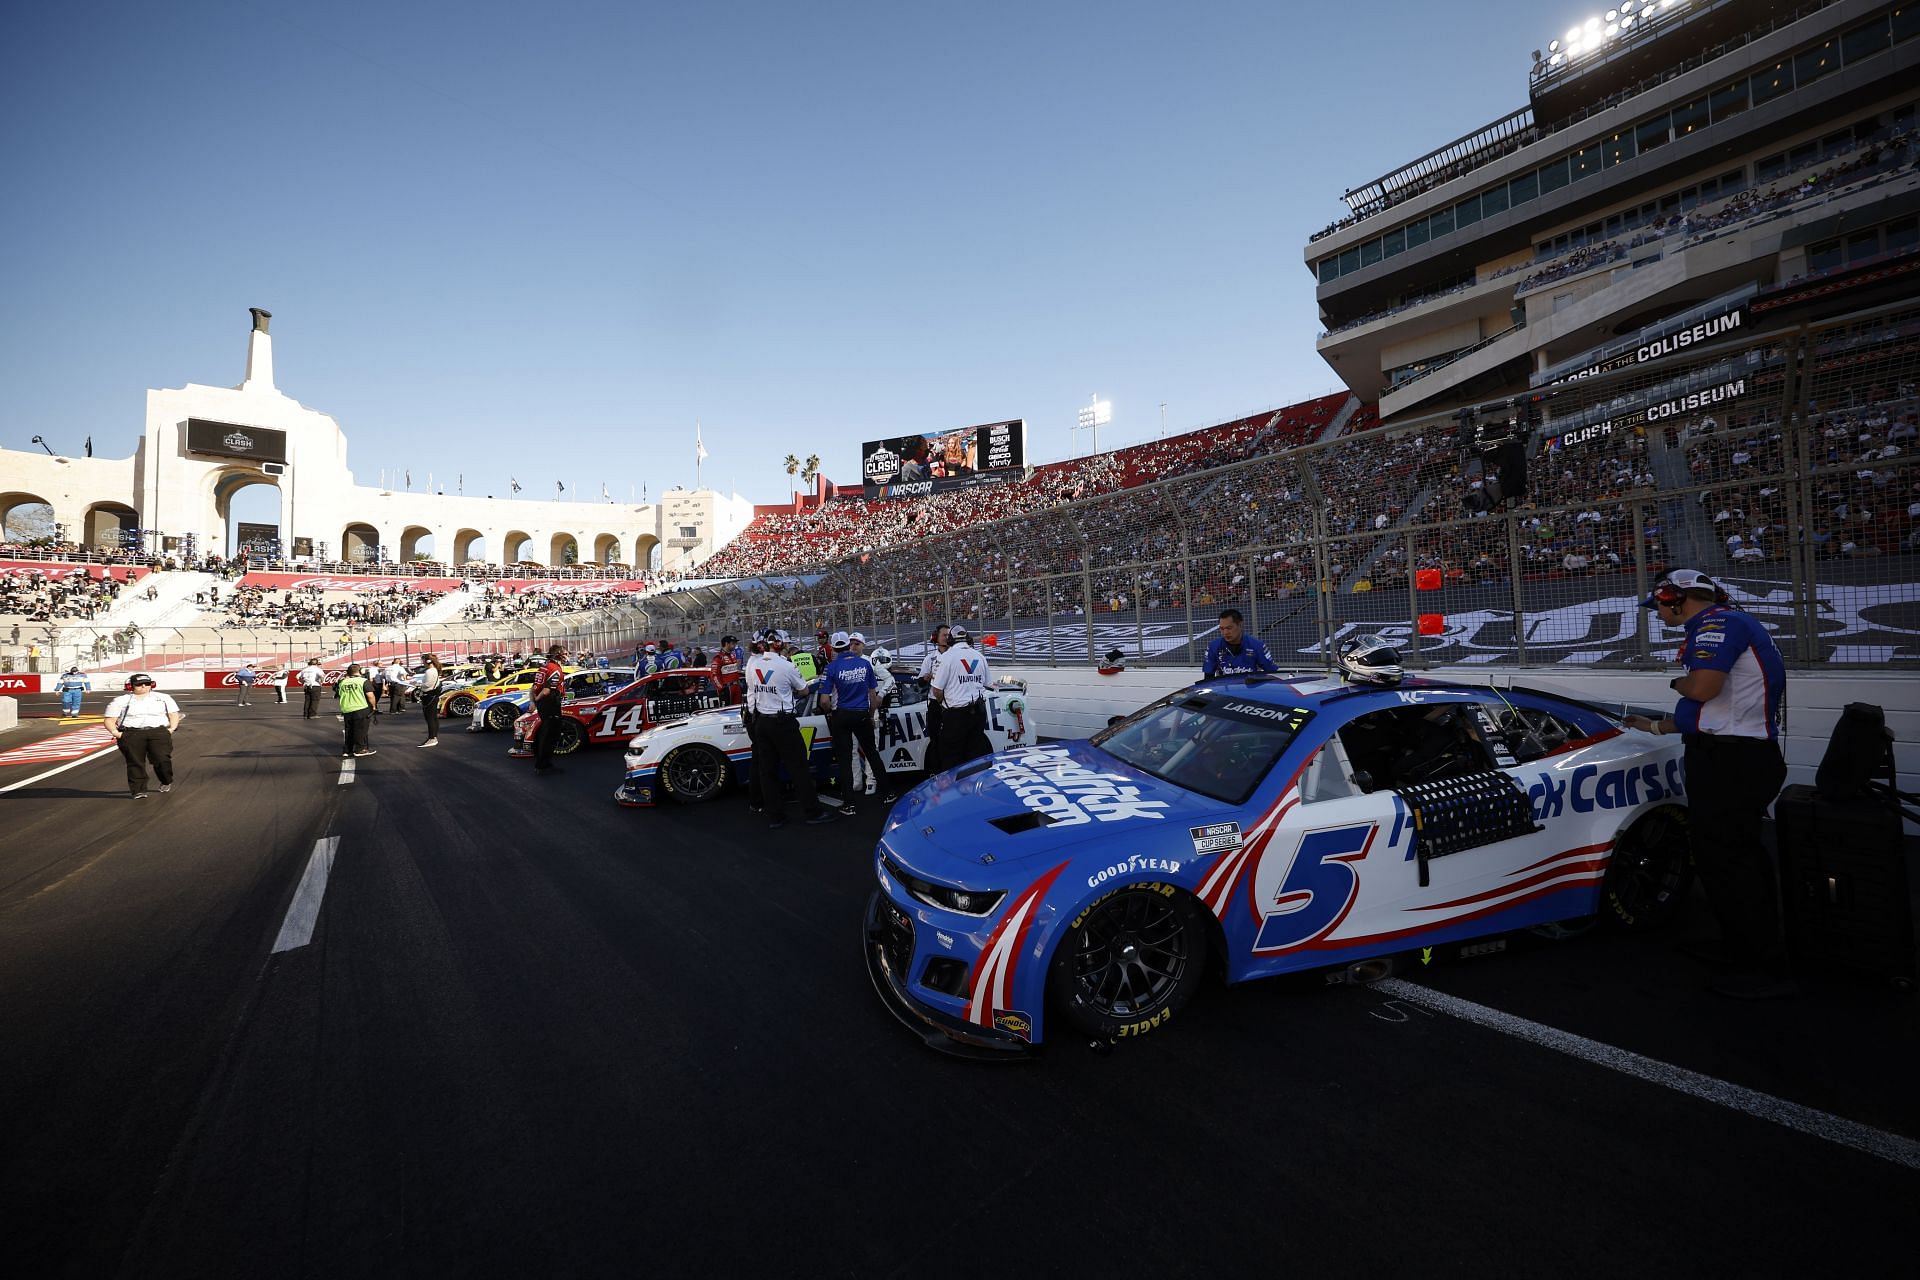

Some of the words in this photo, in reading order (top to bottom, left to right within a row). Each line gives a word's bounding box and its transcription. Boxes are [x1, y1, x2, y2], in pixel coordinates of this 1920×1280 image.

[1615, 356, 1636, 368] THE
[1637, 310, 1741, 363] COLISEUM
[1563, 420, 1611, 446] CLASH
[1647, 380, 1745, 421] COLISEUM
[225, 438, 252, 447] CLASH
[989, 434, 1011, 444] BUSCH
[866, 460, 898, 474] CLASH
[988, 458, 1012, 468] xfinity
[892, 481, 933, 498] NASCAR
[596, 704, 643, 736] 14
[1222, 702, 1290, 721] LARSON
[1003, 743, 1027, 751] LIBERTY
[1206, 824, 1233, 837] NASCAR
[1201, 839, 1214, 848] CUP
[1214, 836, 1236, 847] SERIES
[1252, 821, 1379, 953] 5
[994, 1016, 1031, 1033] SUNOCO
[1118, 1006, 1172, 1038] EAGLE
